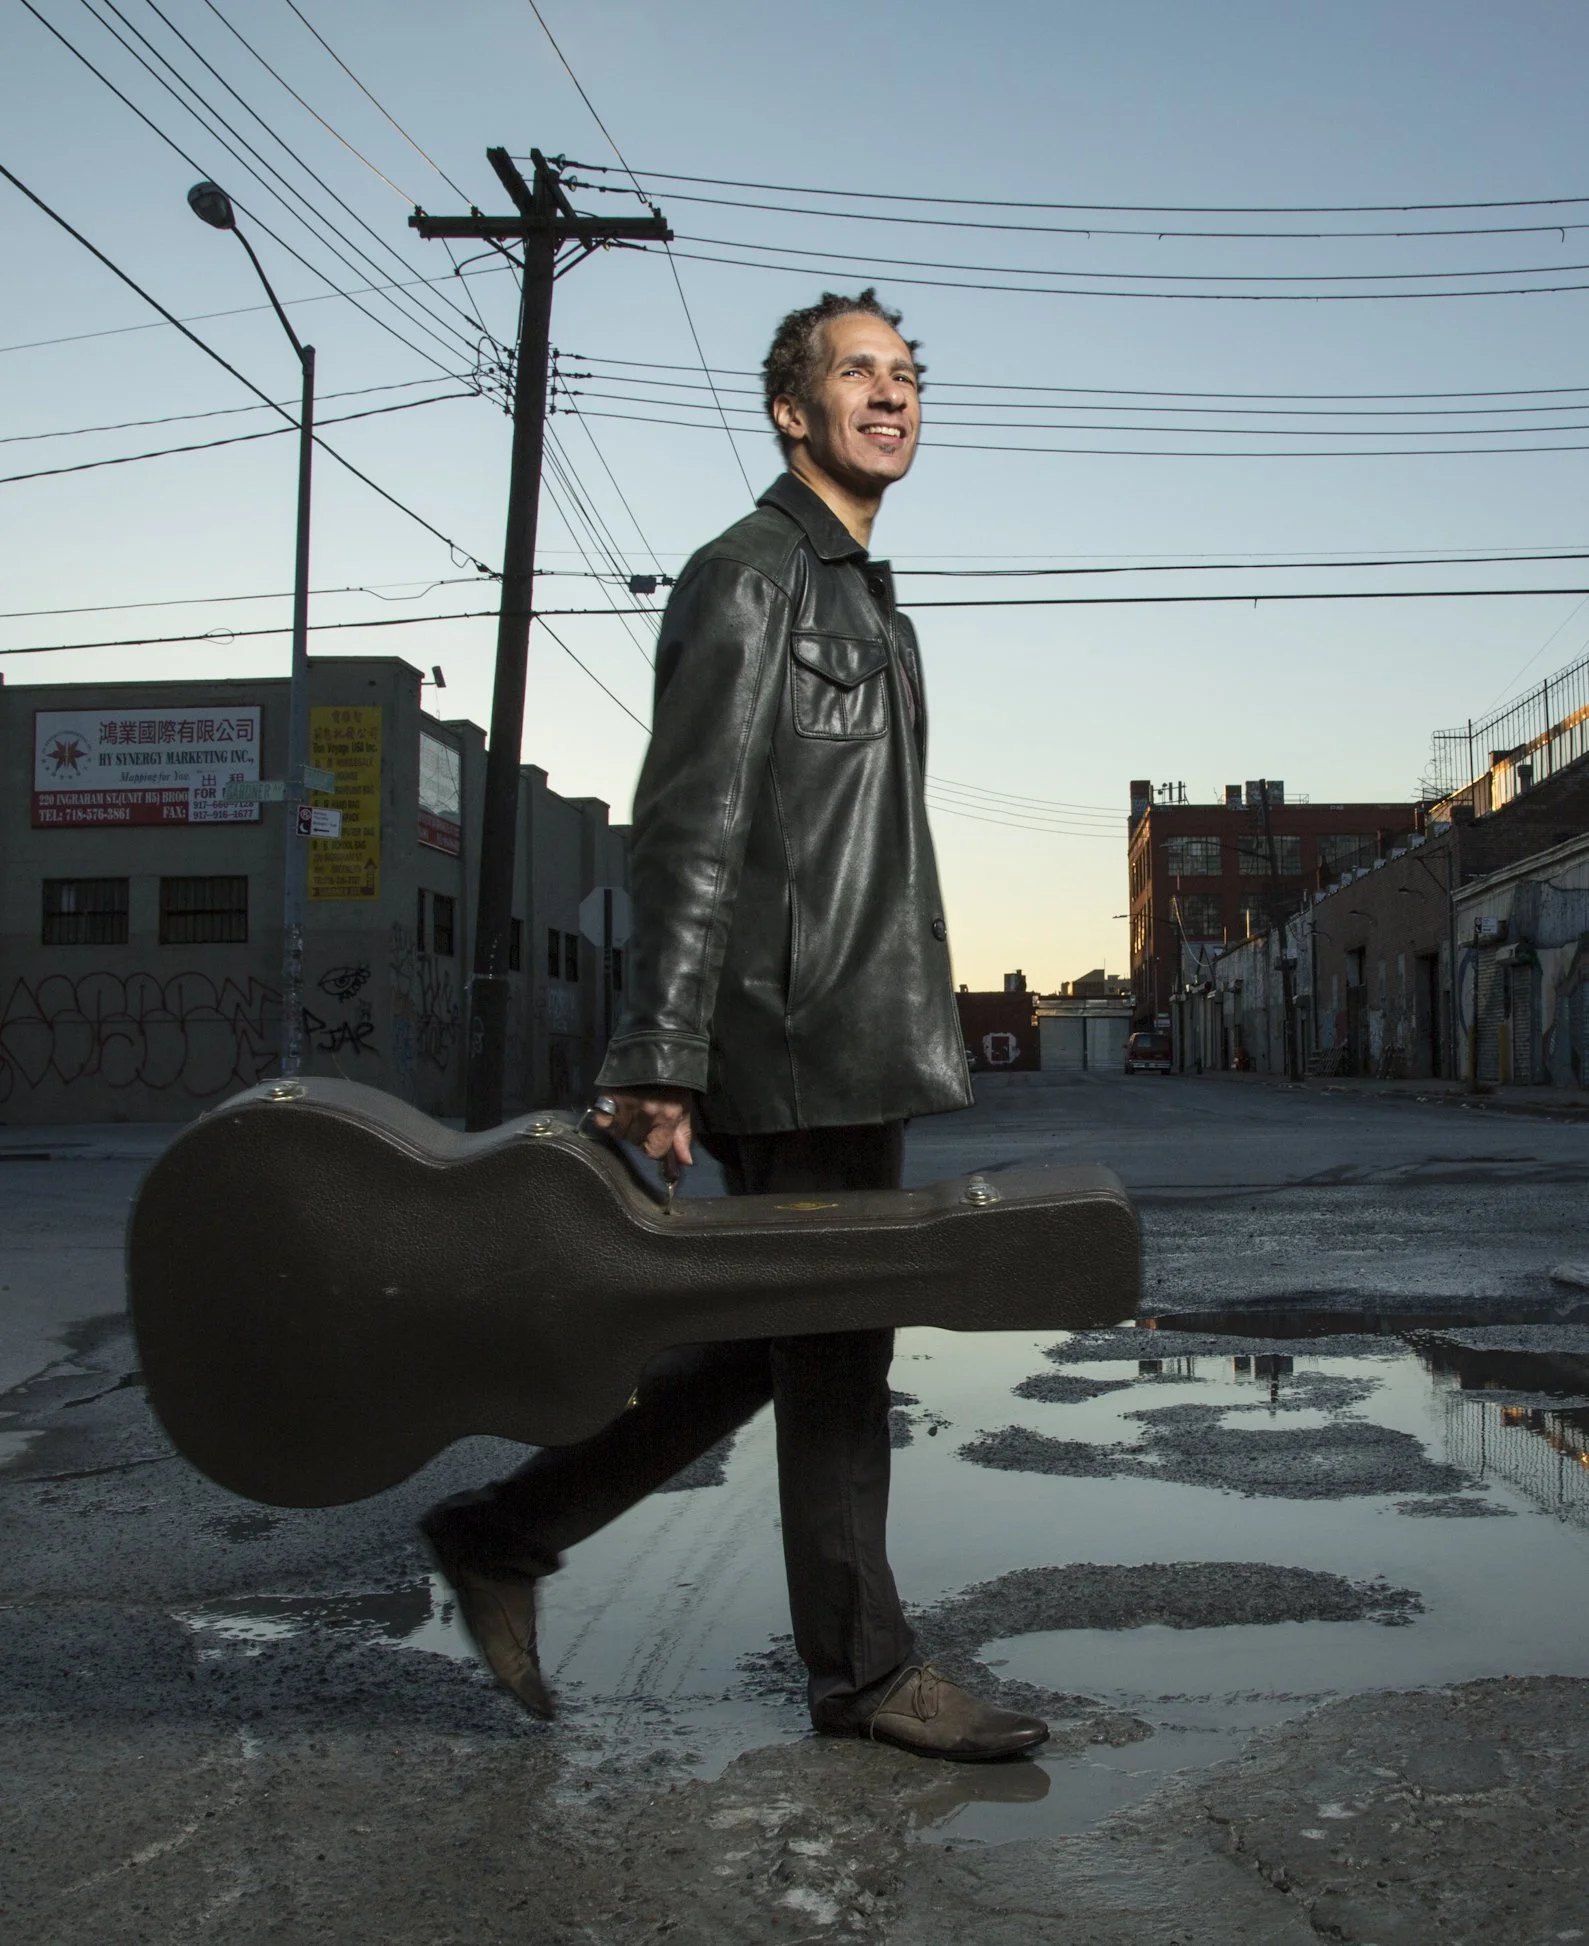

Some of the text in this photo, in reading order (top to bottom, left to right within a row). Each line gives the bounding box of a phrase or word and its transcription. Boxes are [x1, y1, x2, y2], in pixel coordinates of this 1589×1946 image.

[99, 718, 254, 745] 鴻業國際有限公司
[99, 753, 115, 766] HY
[116, 751, 163, 766] SYNERGY
[166, 749, 228, 765] MARKETING
[120, 771, 158, 784] Mapping
[159, 771, 171, 783] for
[56, 793, 104, 805] INGRAHAM
[194, 788, 217, 799] FOR
[40, 806, 187, 822] TEL: 718-576-3861 FAX:
[193, 809, 254, 820] 917-916-1677
